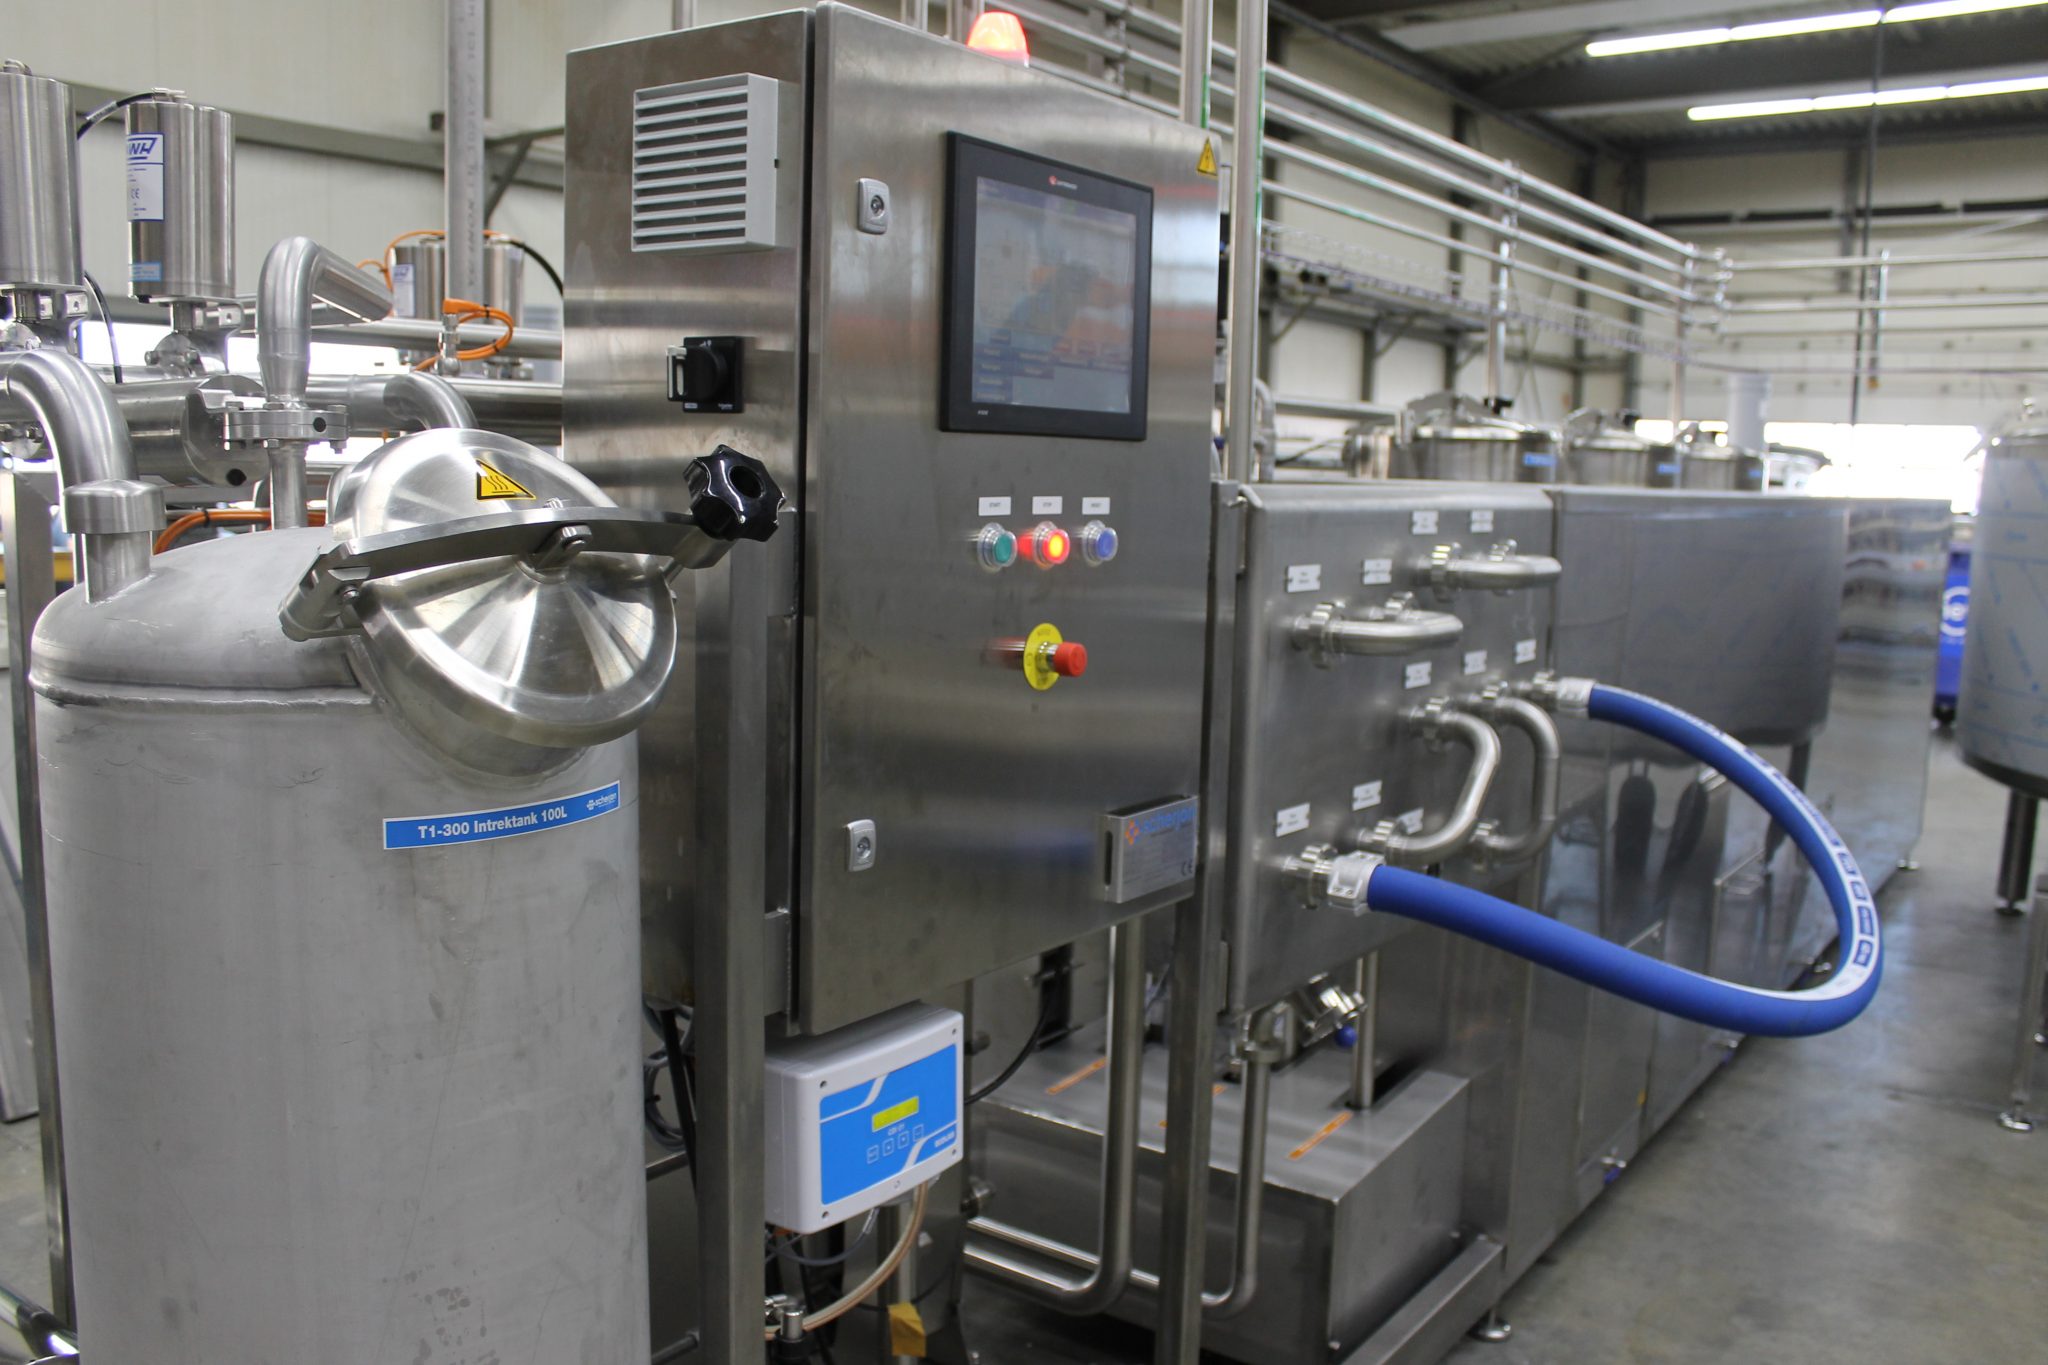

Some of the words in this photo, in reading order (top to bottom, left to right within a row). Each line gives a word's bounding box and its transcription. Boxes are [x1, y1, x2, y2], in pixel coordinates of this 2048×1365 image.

[418, 821, 470, 840] T1-300
[474, 811, 538, 834] Intrektank
[540, 805, 568, 823] 100L
